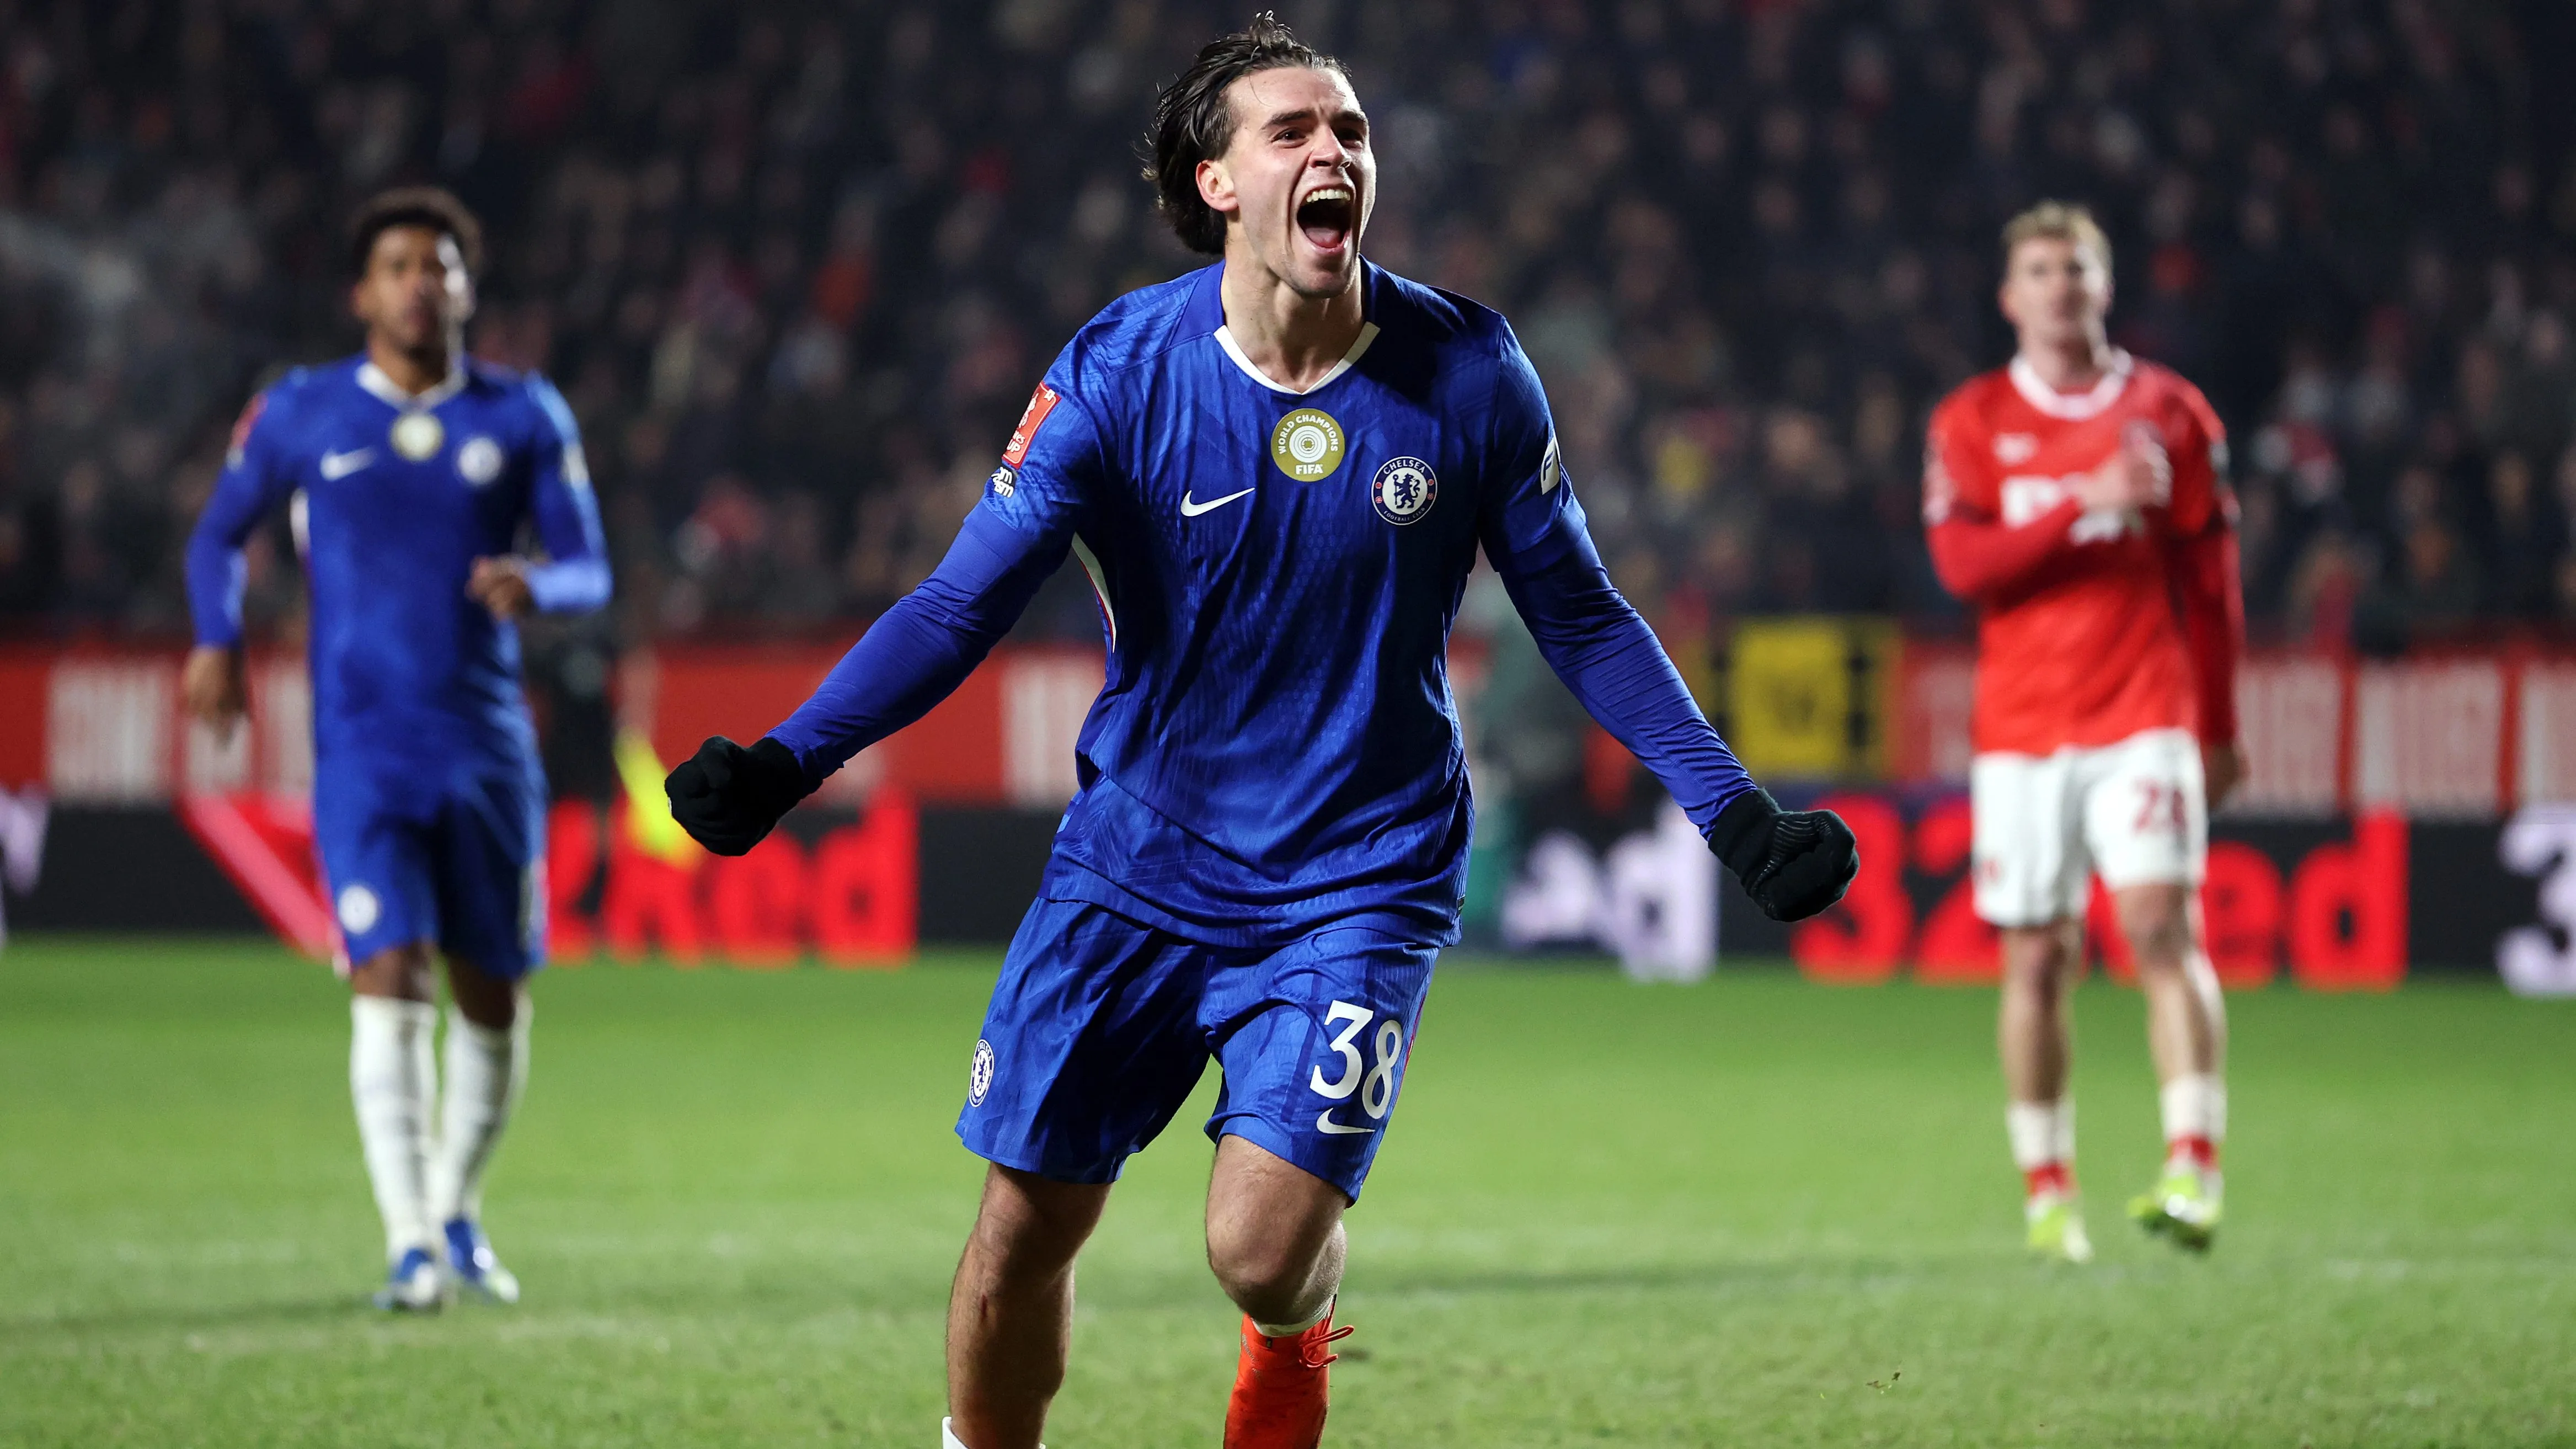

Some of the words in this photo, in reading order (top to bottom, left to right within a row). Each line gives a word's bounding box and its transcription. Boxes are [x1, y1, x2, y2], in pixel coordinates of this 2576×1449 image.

[1278, 421, 1295, 454] WORLD
[1295, 414, 1338, 451] CHAMPIONS
[1006, 439, 1020, 453] UP
[1296, 464, 1323, 475] FIFA
[1383, 460, 1425, 475] CHELSEA
[1310, 1000, 1402, 1119] 38
